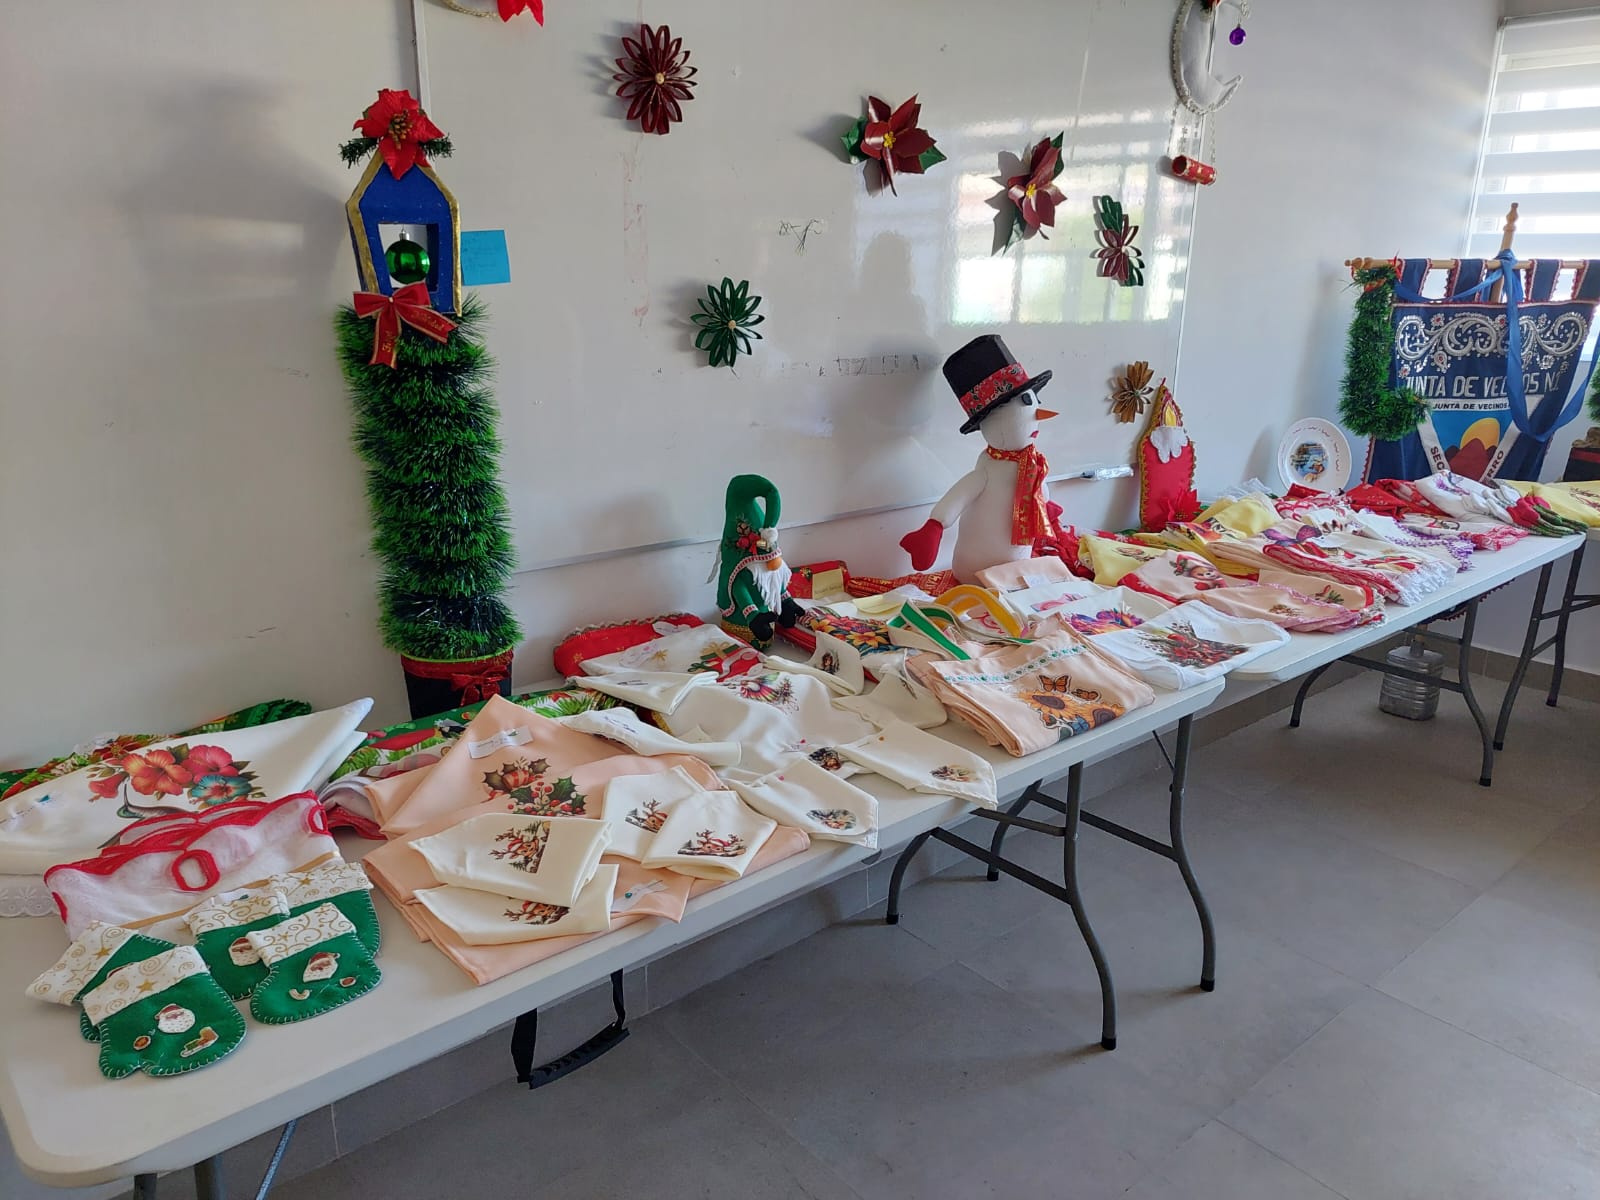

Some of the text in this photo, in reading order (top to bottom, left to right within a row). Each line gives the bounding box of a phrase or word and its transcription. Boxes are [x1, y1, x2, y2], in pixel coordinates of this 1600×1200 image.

[1452, 375, 1479, 397] DE
[1433, 402, 1508, 410] JUNTA DE VECINOS
